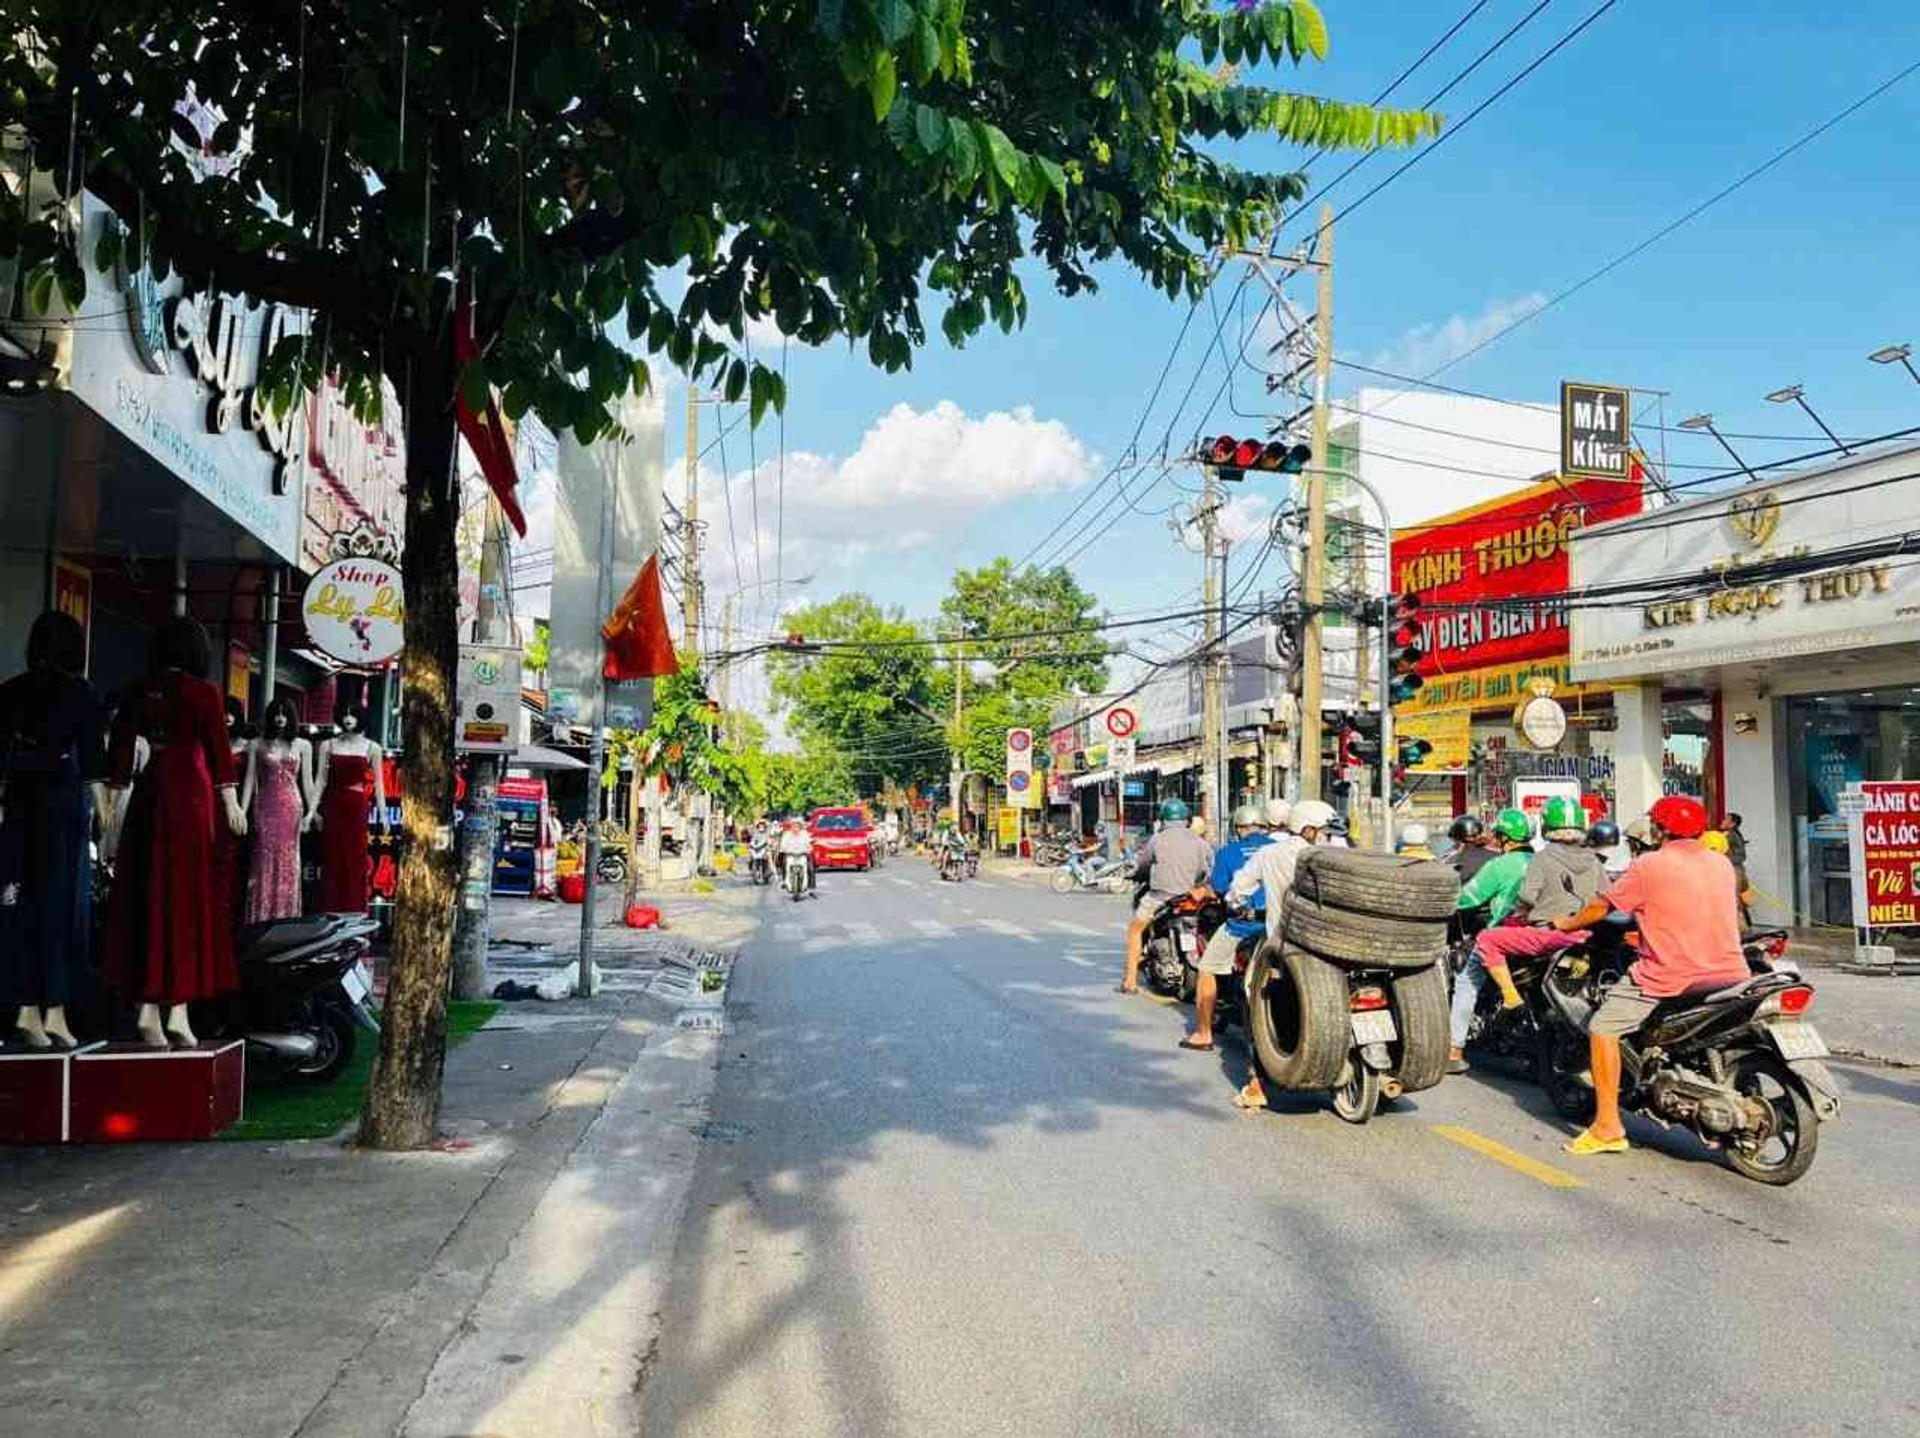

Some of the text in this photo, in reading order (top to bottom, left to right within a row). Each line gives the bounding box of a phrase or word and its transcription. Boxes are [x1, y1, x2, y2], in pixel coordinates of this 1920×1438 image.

[1573, 433, 1621, 470] KÍNH
[331, 565, 388, 587] Shop
[1401, 547, 1462, 595] KÍNH
[1866, 818, 1918, 845] CÁ LÓC
